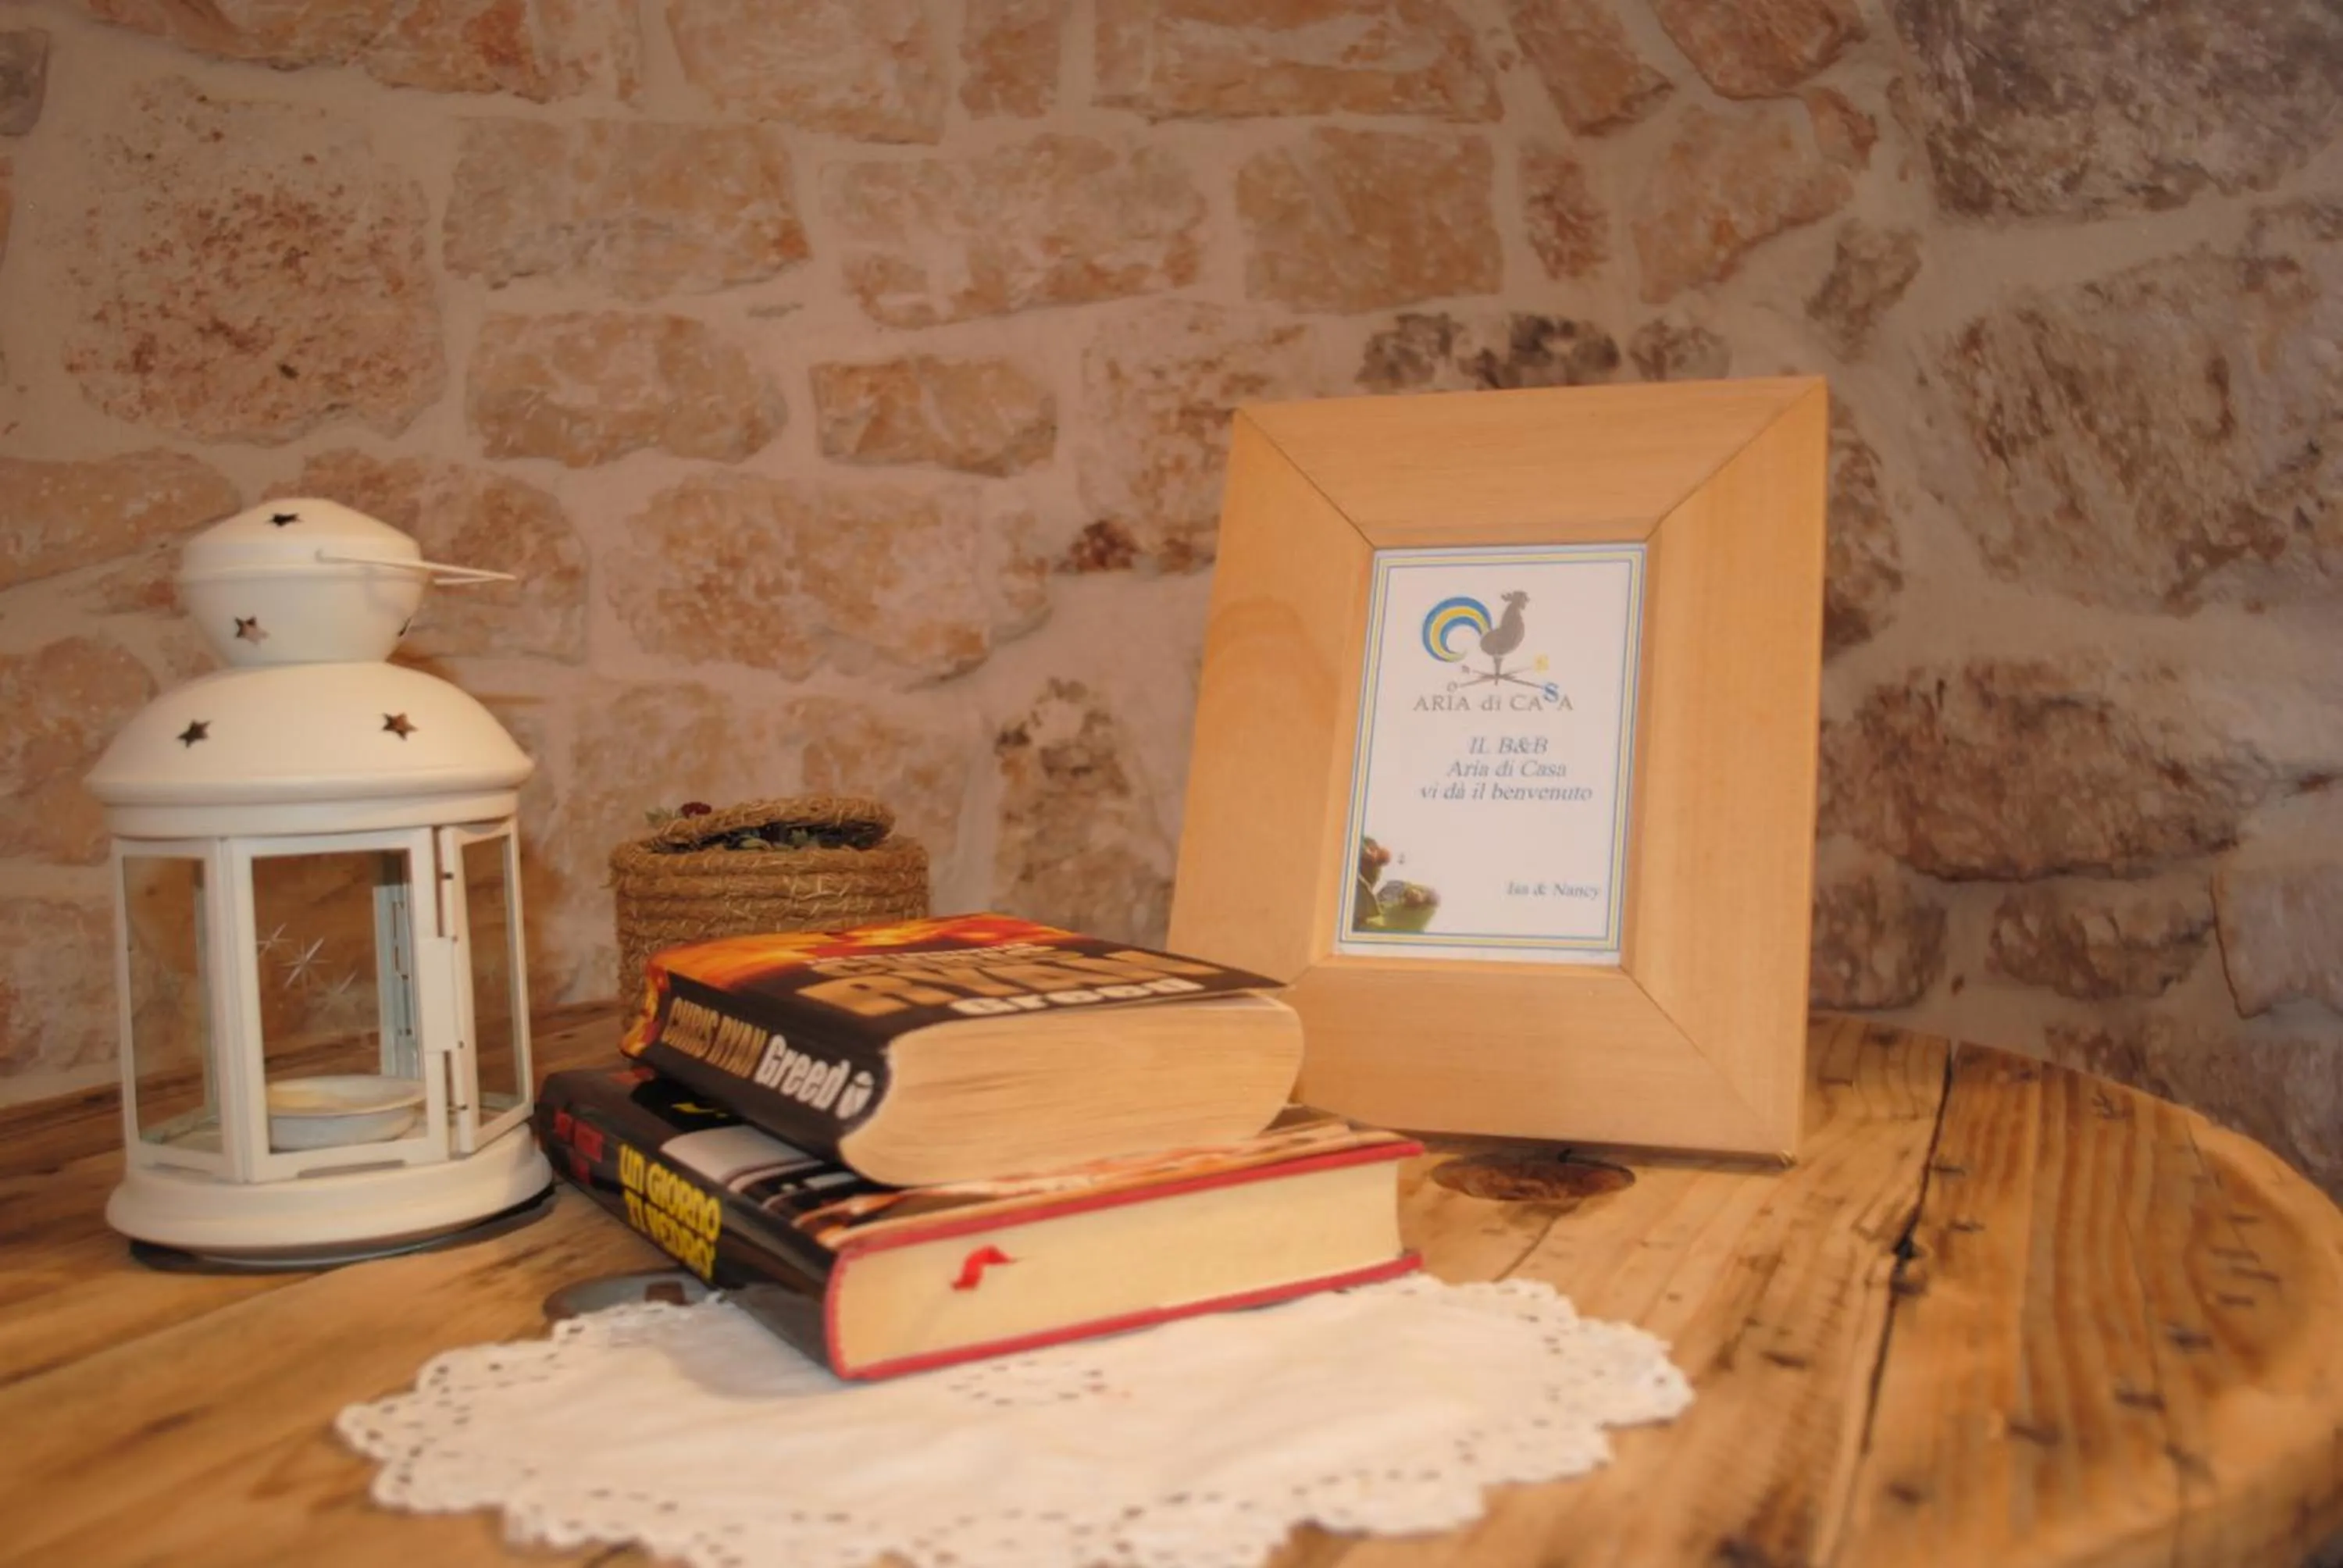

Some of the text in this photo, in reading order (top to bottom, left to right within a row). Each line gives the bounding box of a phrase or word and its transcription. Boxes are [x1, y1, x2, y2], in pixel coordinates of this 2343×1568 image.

[1413, 682, 1574, 711] ARIA di CASA
[1468, 736, 1549, 754] IL B&B
[1447, 759, 1567, 778] Aria di Casa
[1421, 782, 1439, 800] vi
[1471, 782, 1485, 800] il
[1491, 782, 1593, 801] benvenuto
[1553, 883, 1599, 902] Nancy
[795, 950, 1221, 1016] RYAN
[948, 978, 1205, 1015] Greed
[704, 1014, 769, 1079] RYAN
[754, 1033, 851, 1112] Greed
[645, 1160, 723, 1245] GIORNO
